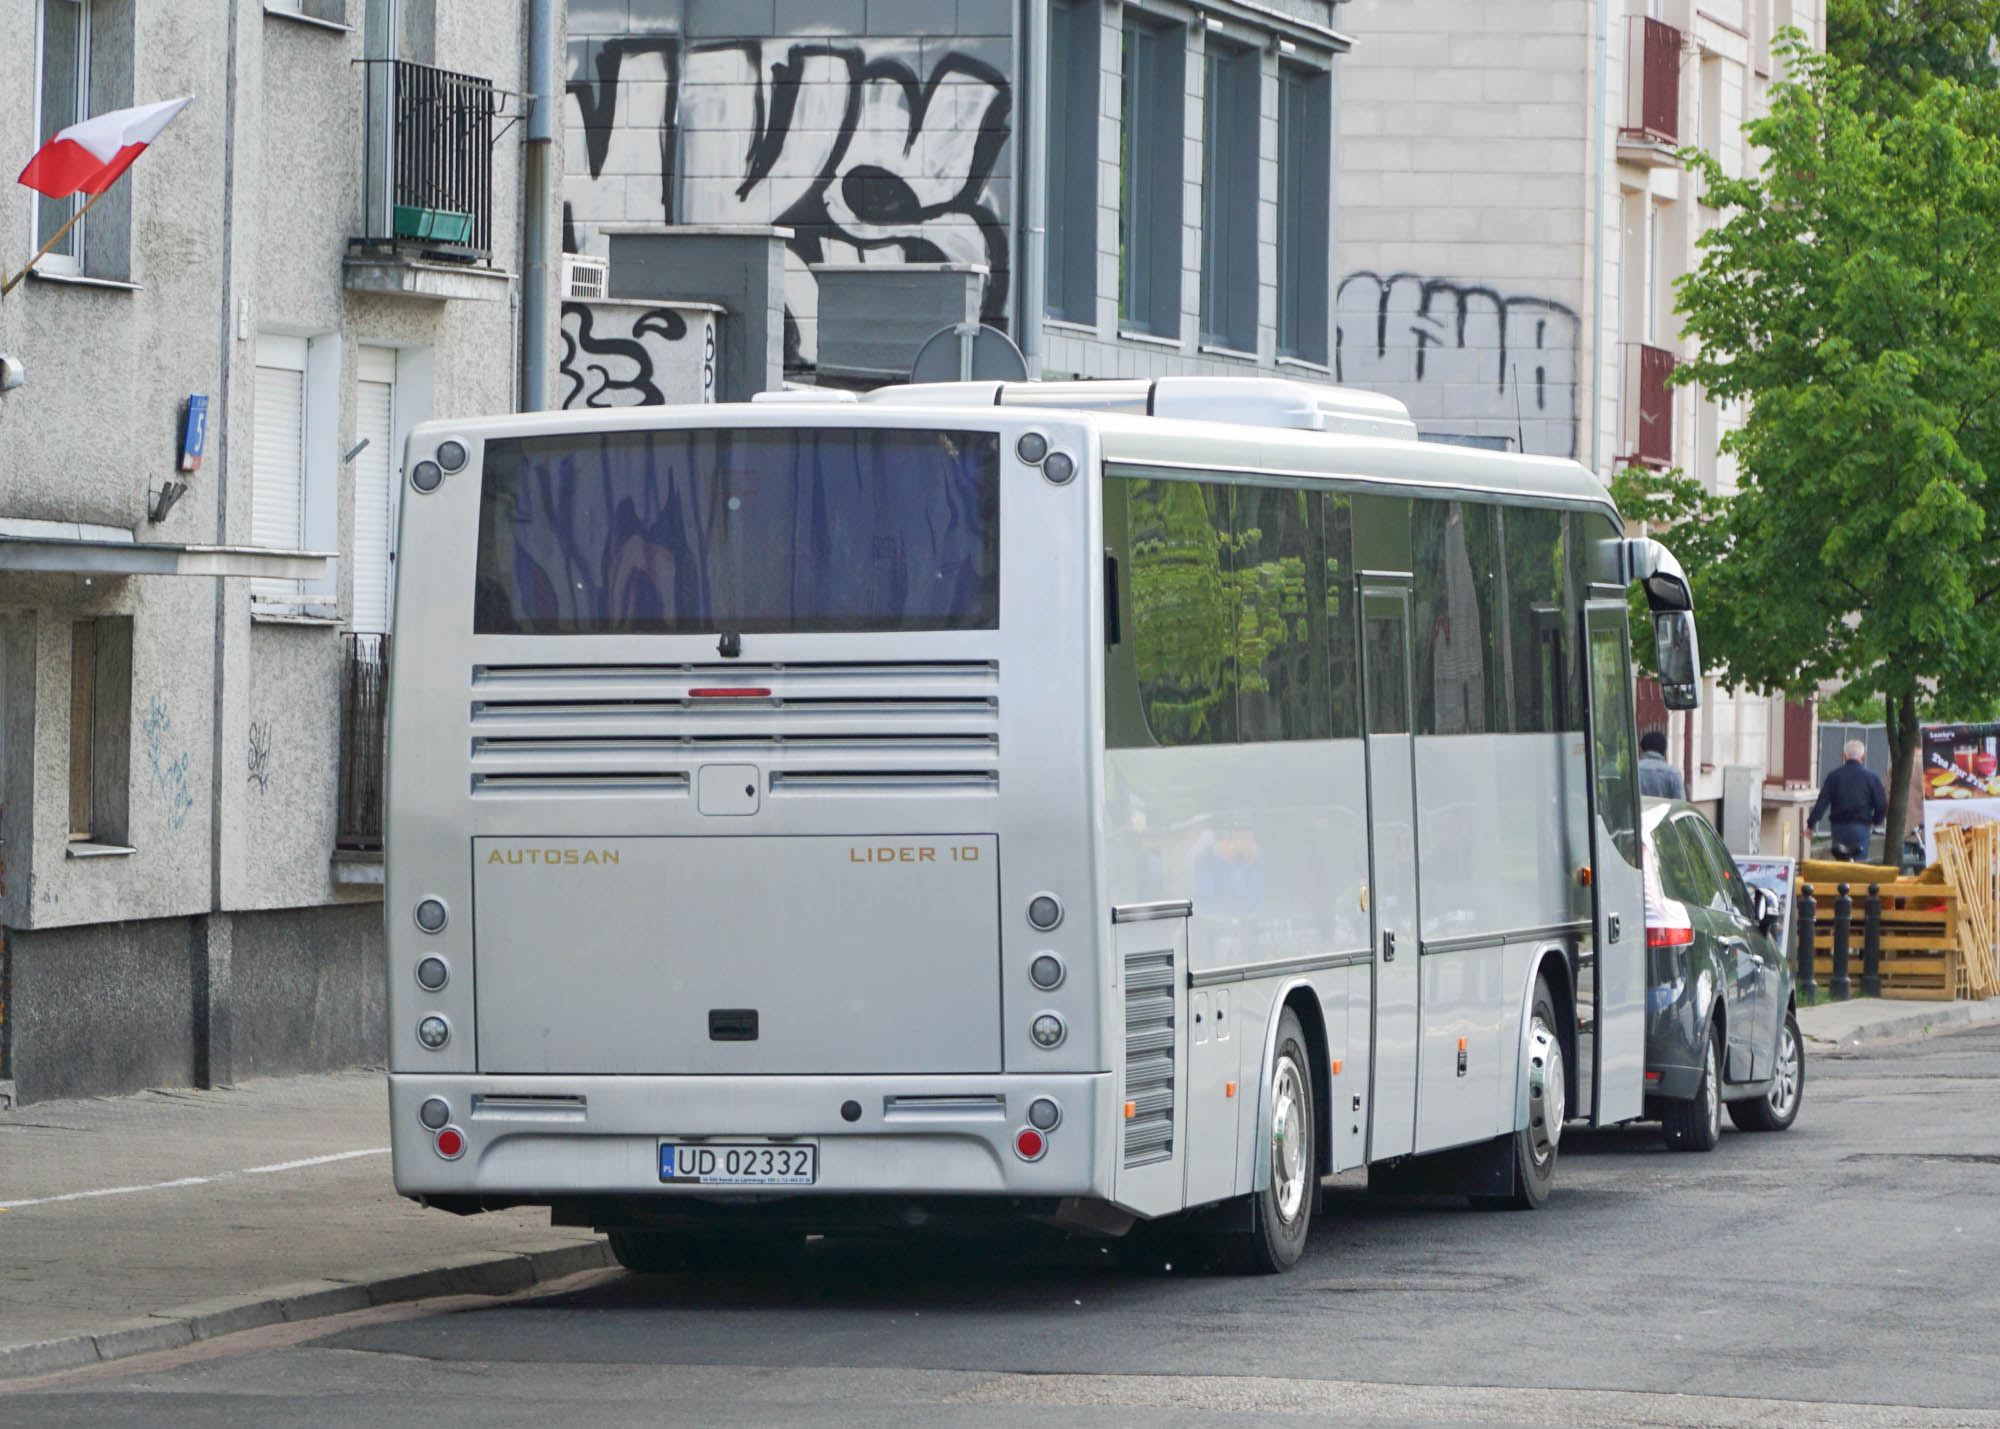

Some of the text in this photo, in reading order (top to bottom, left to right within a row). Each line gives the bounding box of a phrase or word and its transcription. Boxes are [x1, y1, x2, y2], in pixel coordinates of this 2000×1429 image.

[194, 413, 204, 452] 5
[487, 849, 620, 864] AUTOSAN
[849, 846, 979, 862] LIDER 10
[678, 1149, 808, 1176] UD 02332
